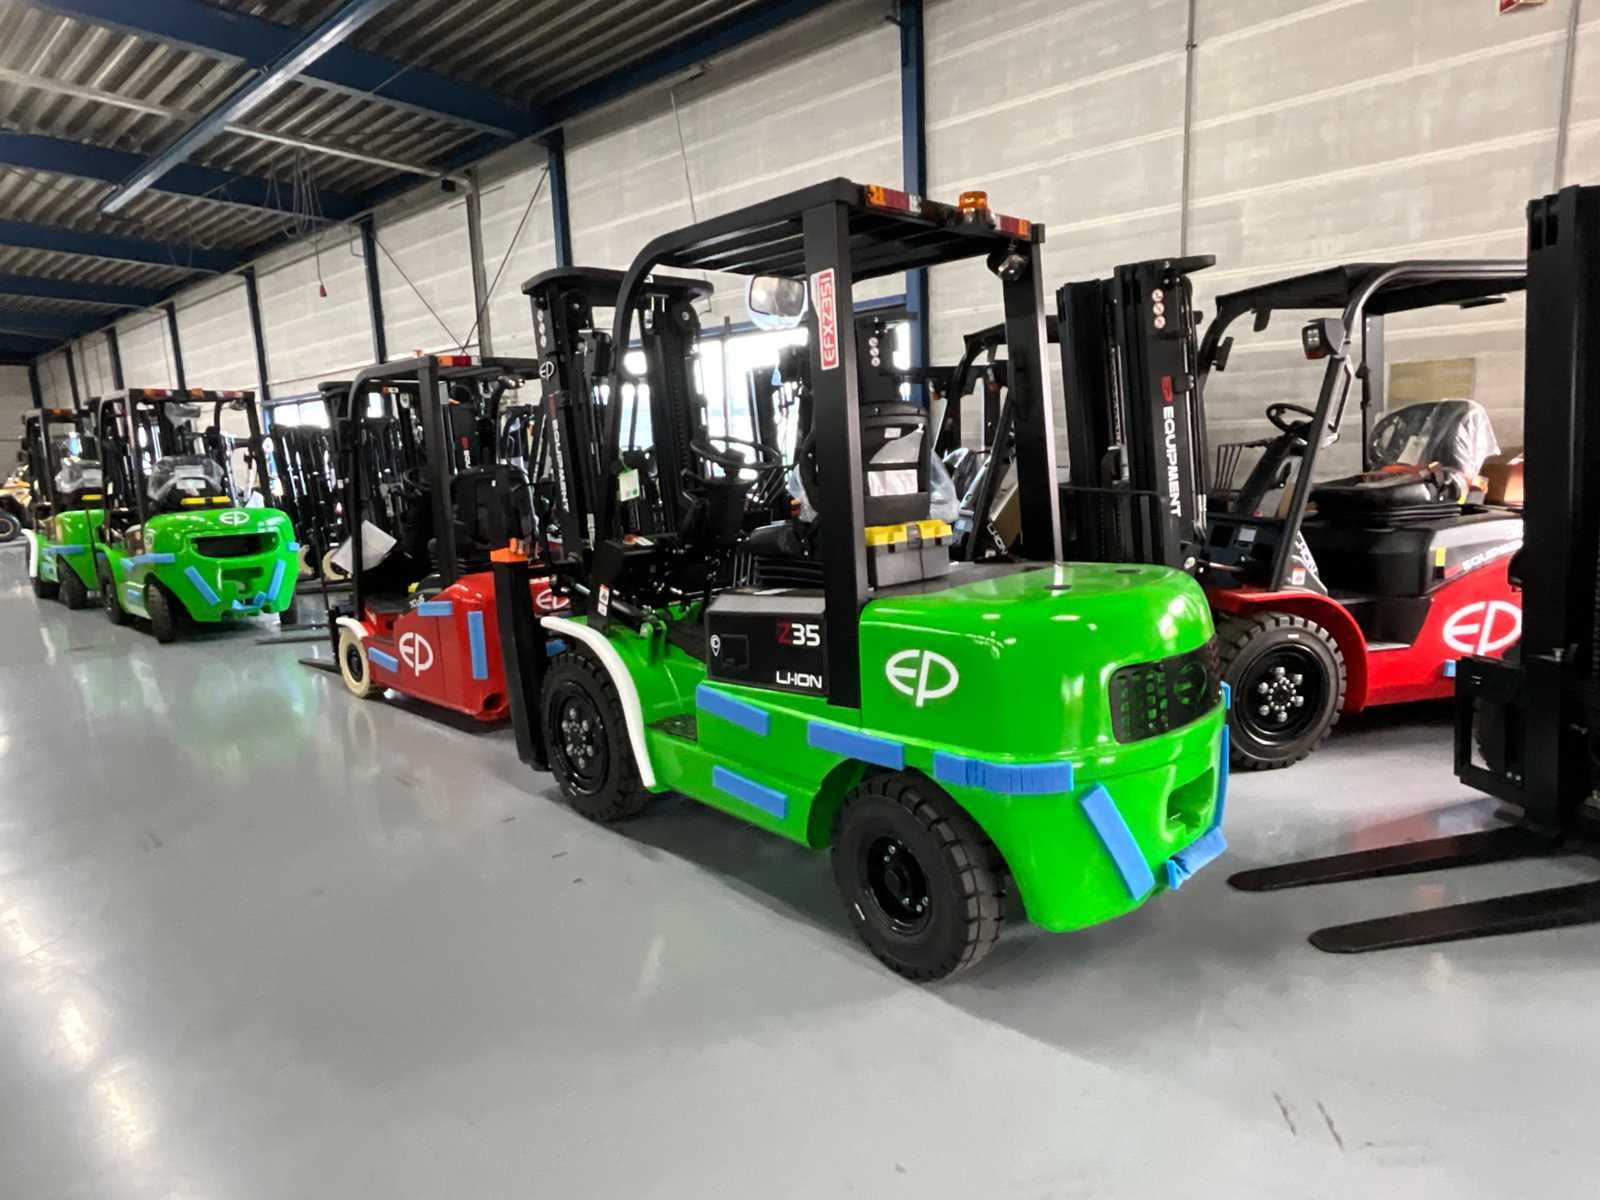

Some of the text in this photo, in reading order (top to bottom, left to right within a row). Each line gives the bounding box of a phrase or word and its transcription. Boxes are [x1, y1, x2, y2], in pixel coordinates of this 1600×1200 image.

[539, 361, 556, 381] EP
[552, 419, 569, 512] EQUIPMENT
[1163, 406, 1182, 517] EQUIPMENT
[219, 511, 250, 526] EP
[776, 622, 821, 647] Z35
[1442, 600, 1522, 656] EP
[399, 632, 434, 678] EP
[886, 649, 959, 707] EP
